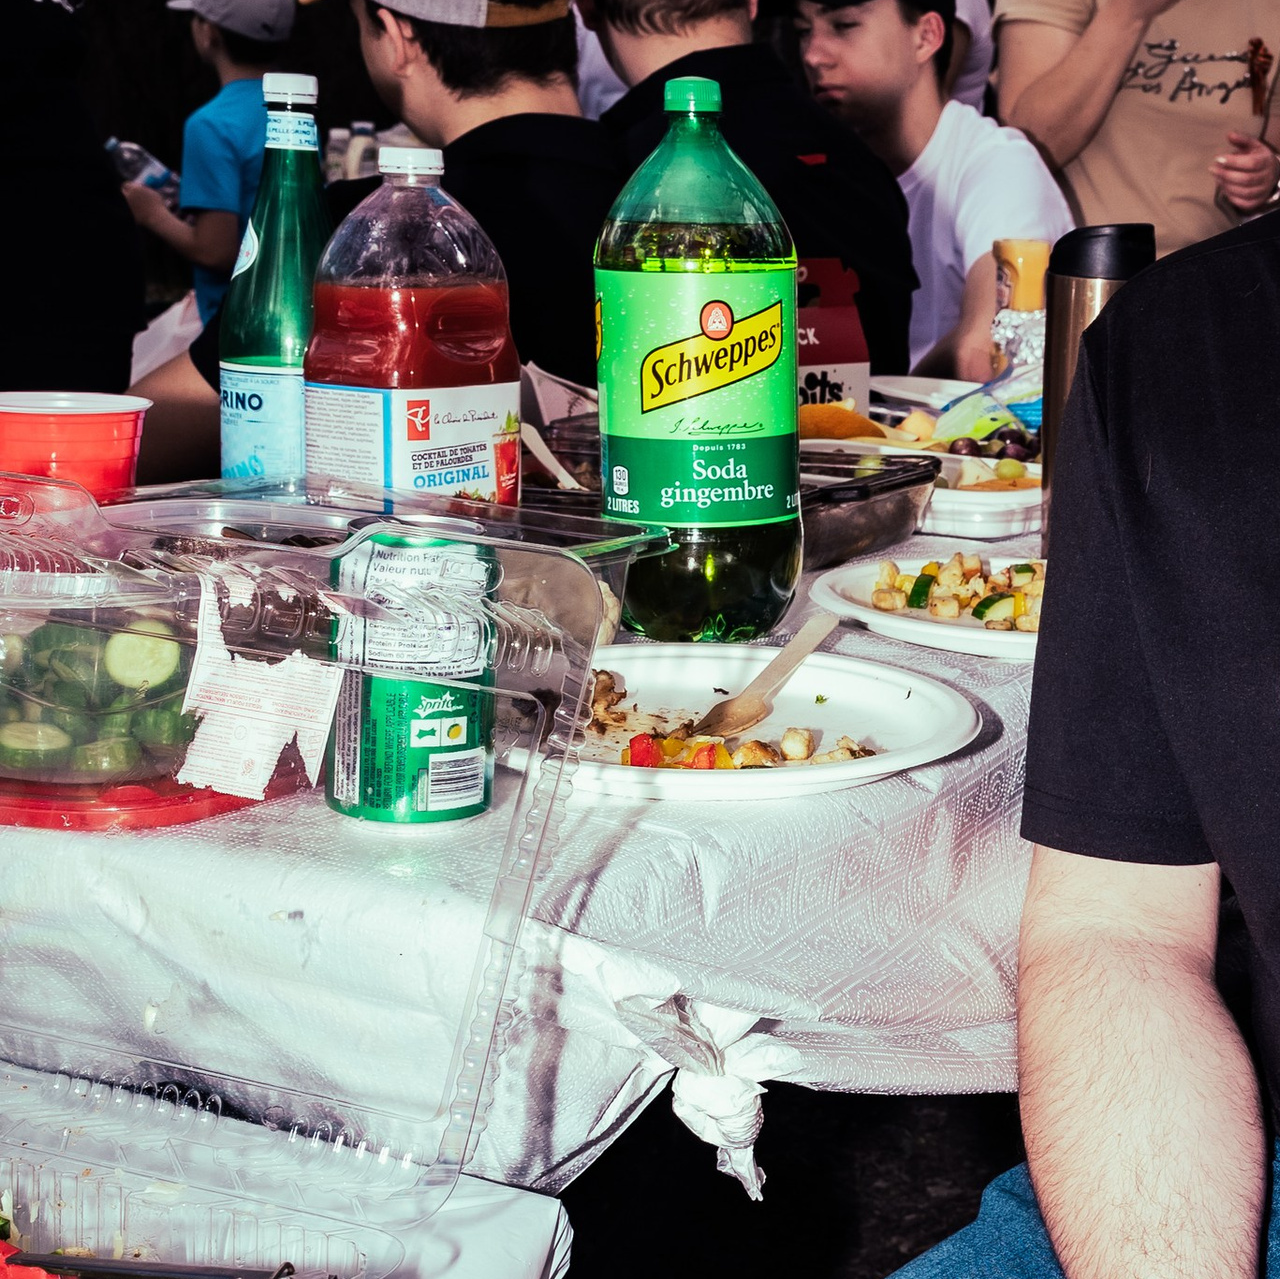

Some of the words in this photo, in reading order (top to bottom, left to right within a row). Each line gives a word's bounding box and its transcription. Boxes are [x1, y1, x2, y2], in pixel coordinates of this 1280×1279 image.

[651, 324, 777, 399] Schweppes
[411, 452, 448, 462] COCKTAIL
[449, 448, 458, 456] DE
[459, 443, 487, 455] TOMATES
[692, 444, 724, 452] Depuis
[412, 462, 422, 470] ET
[424, 460, 434, 469] DE
[435, 454, 473, 468] PALOURDES
[692, 457, 748, 480] Soda
[413, 465, 489, 489] ORIGINAL
[660, 480, 774, 508] gingembre
[607, 496, 612, 509] 2
[612, 497, 640, 514] LITRES
[375, 549, 420, 562] Nutrition
[373, 562, 407, 574] Valeur
[368, 649, 394, 658] Sodium
[385, 692, 396, 727] APPLICABLE
[418, 696, 454, 713] Sprite
[385, 729, 395, 750] WHERE
[384, 751, 394, 773] REFUND
[384, 774, 393, 786] FOR
